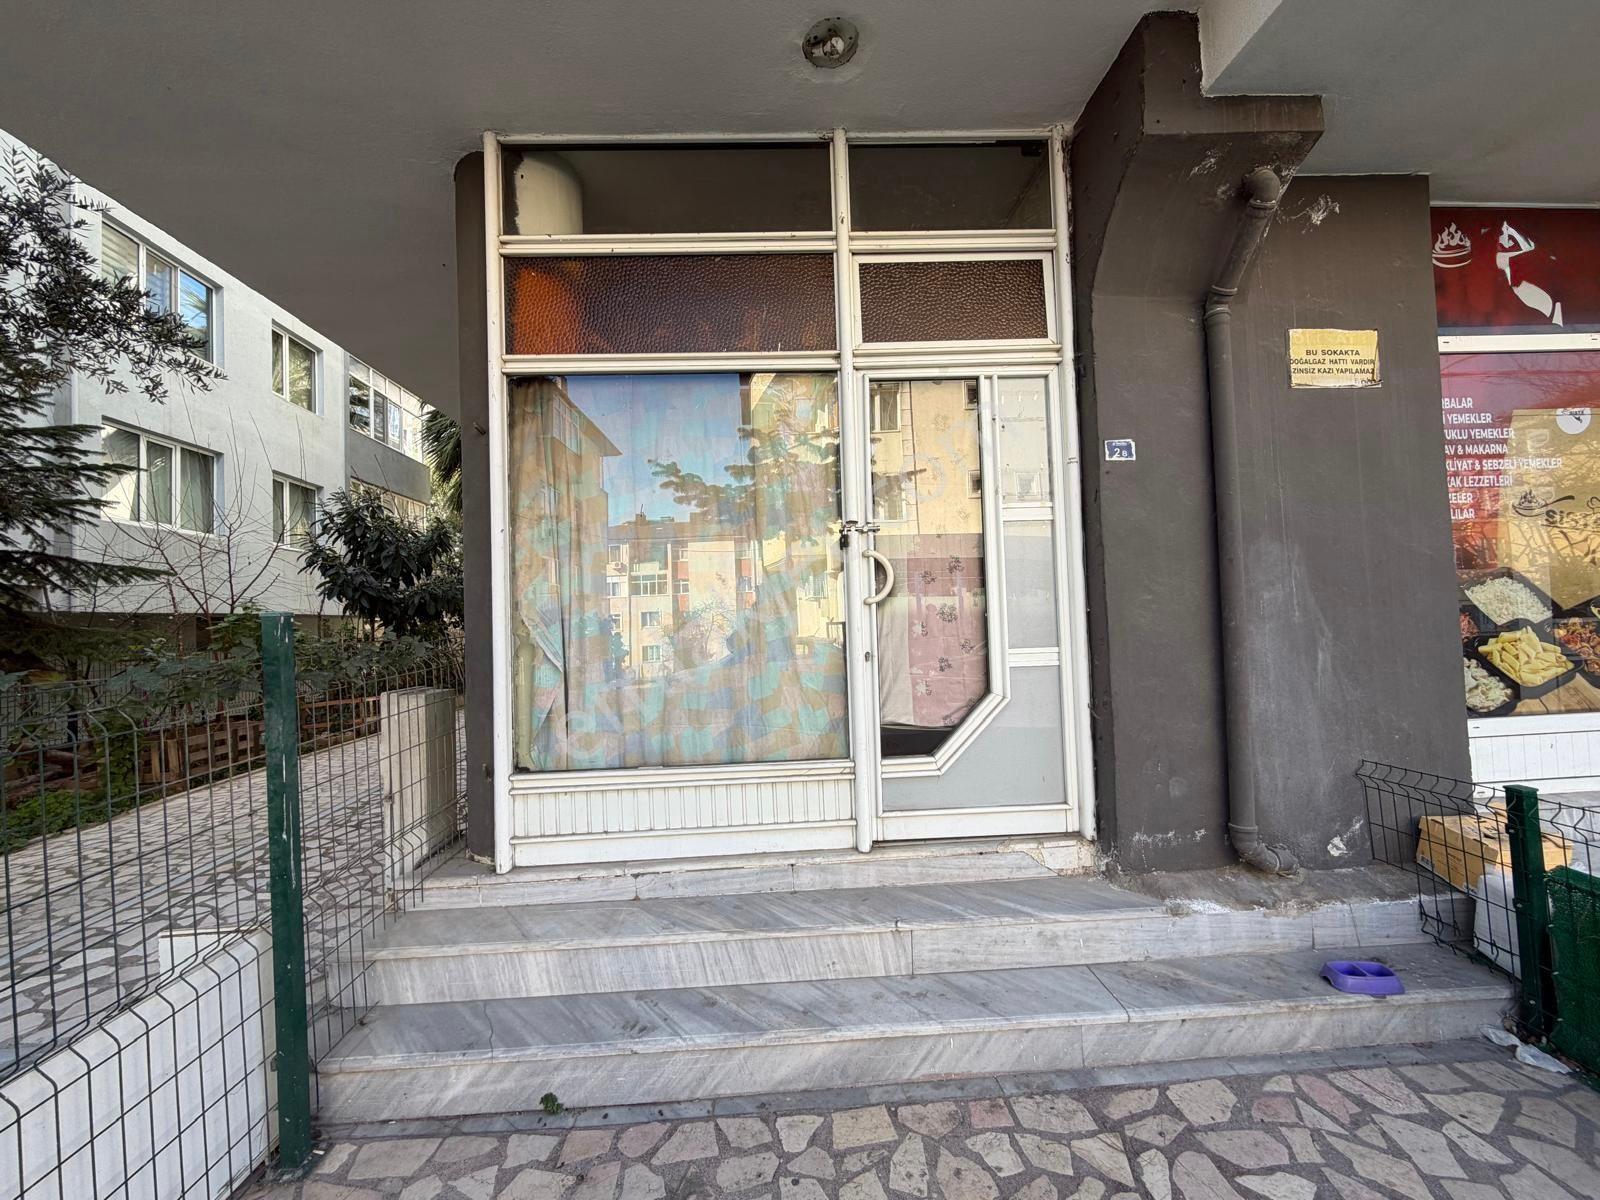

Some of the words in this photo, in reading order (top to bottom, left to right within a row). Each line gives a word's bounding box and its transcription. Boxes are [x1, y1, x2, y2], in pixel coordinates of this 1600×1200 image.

[1317, 367, 1334, 375] KAZI
[1447, 413, 1492, 424] YEMEKLER
[1443, 429, 1469, 440] UKLU
[1470, 428, 1515, 440] YEMEKLER
[1457, 444, 1463, 455] &
[1465, 444, 1509, 455] MAKARNA
[1475, 459, 1481, 470] &
[1482, 457, 1517, 470] SEBZELİ
[1518, 457, 1562, 469] YEMEKLER
[1464, 474, 1513, 487] LEZZETLERİ
